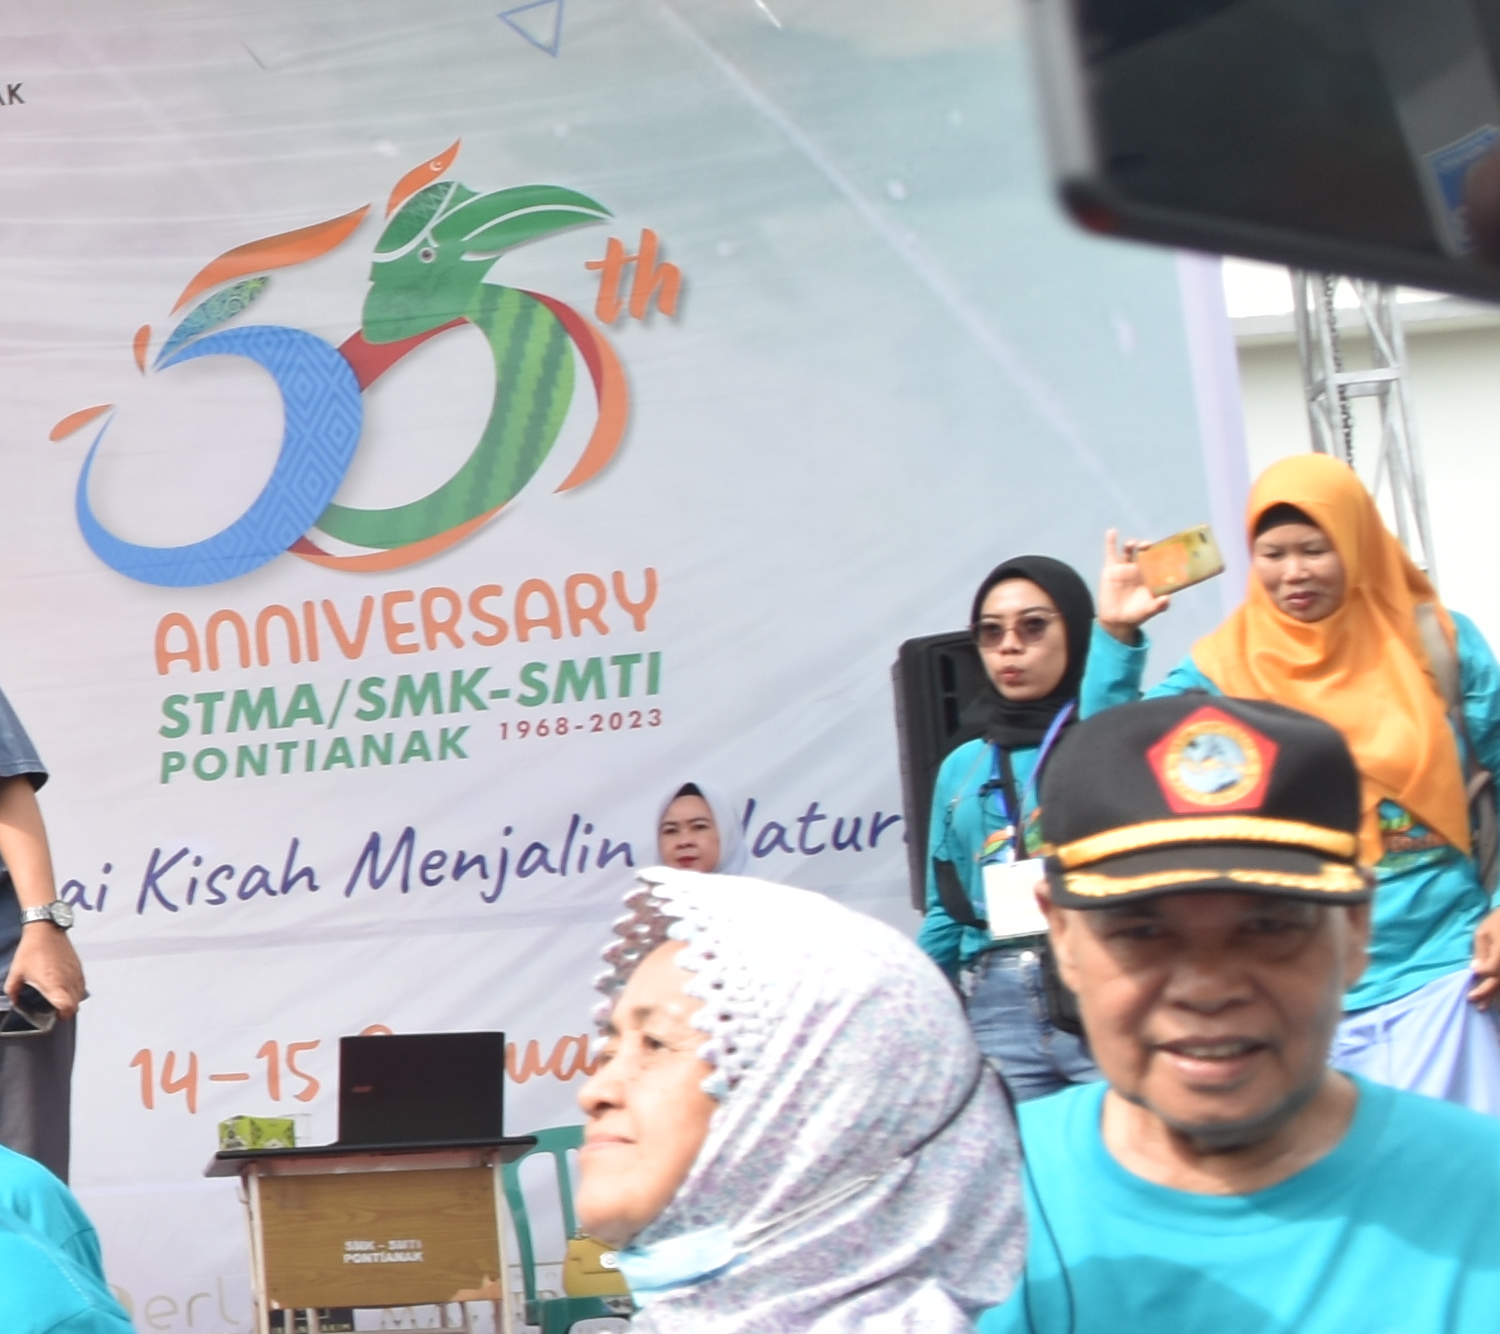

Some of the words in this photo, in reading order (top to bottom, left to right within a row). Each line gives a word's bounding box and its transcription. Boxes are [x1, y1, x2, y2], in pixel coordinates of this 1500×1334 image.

[153, 566, 659, 675] ANNIVERSARY
[158, 650, 662, 739] STMA/SMK-SMTI
[159, 724, 472, 786] PONTIANAK
[497, 708, 663, 741] 1968-2023
[136, 835, 321, 916] Kisah
[343, 813, 634, 909] Menjalin
[342, 1250, 424, 1264] PONTIANAK
